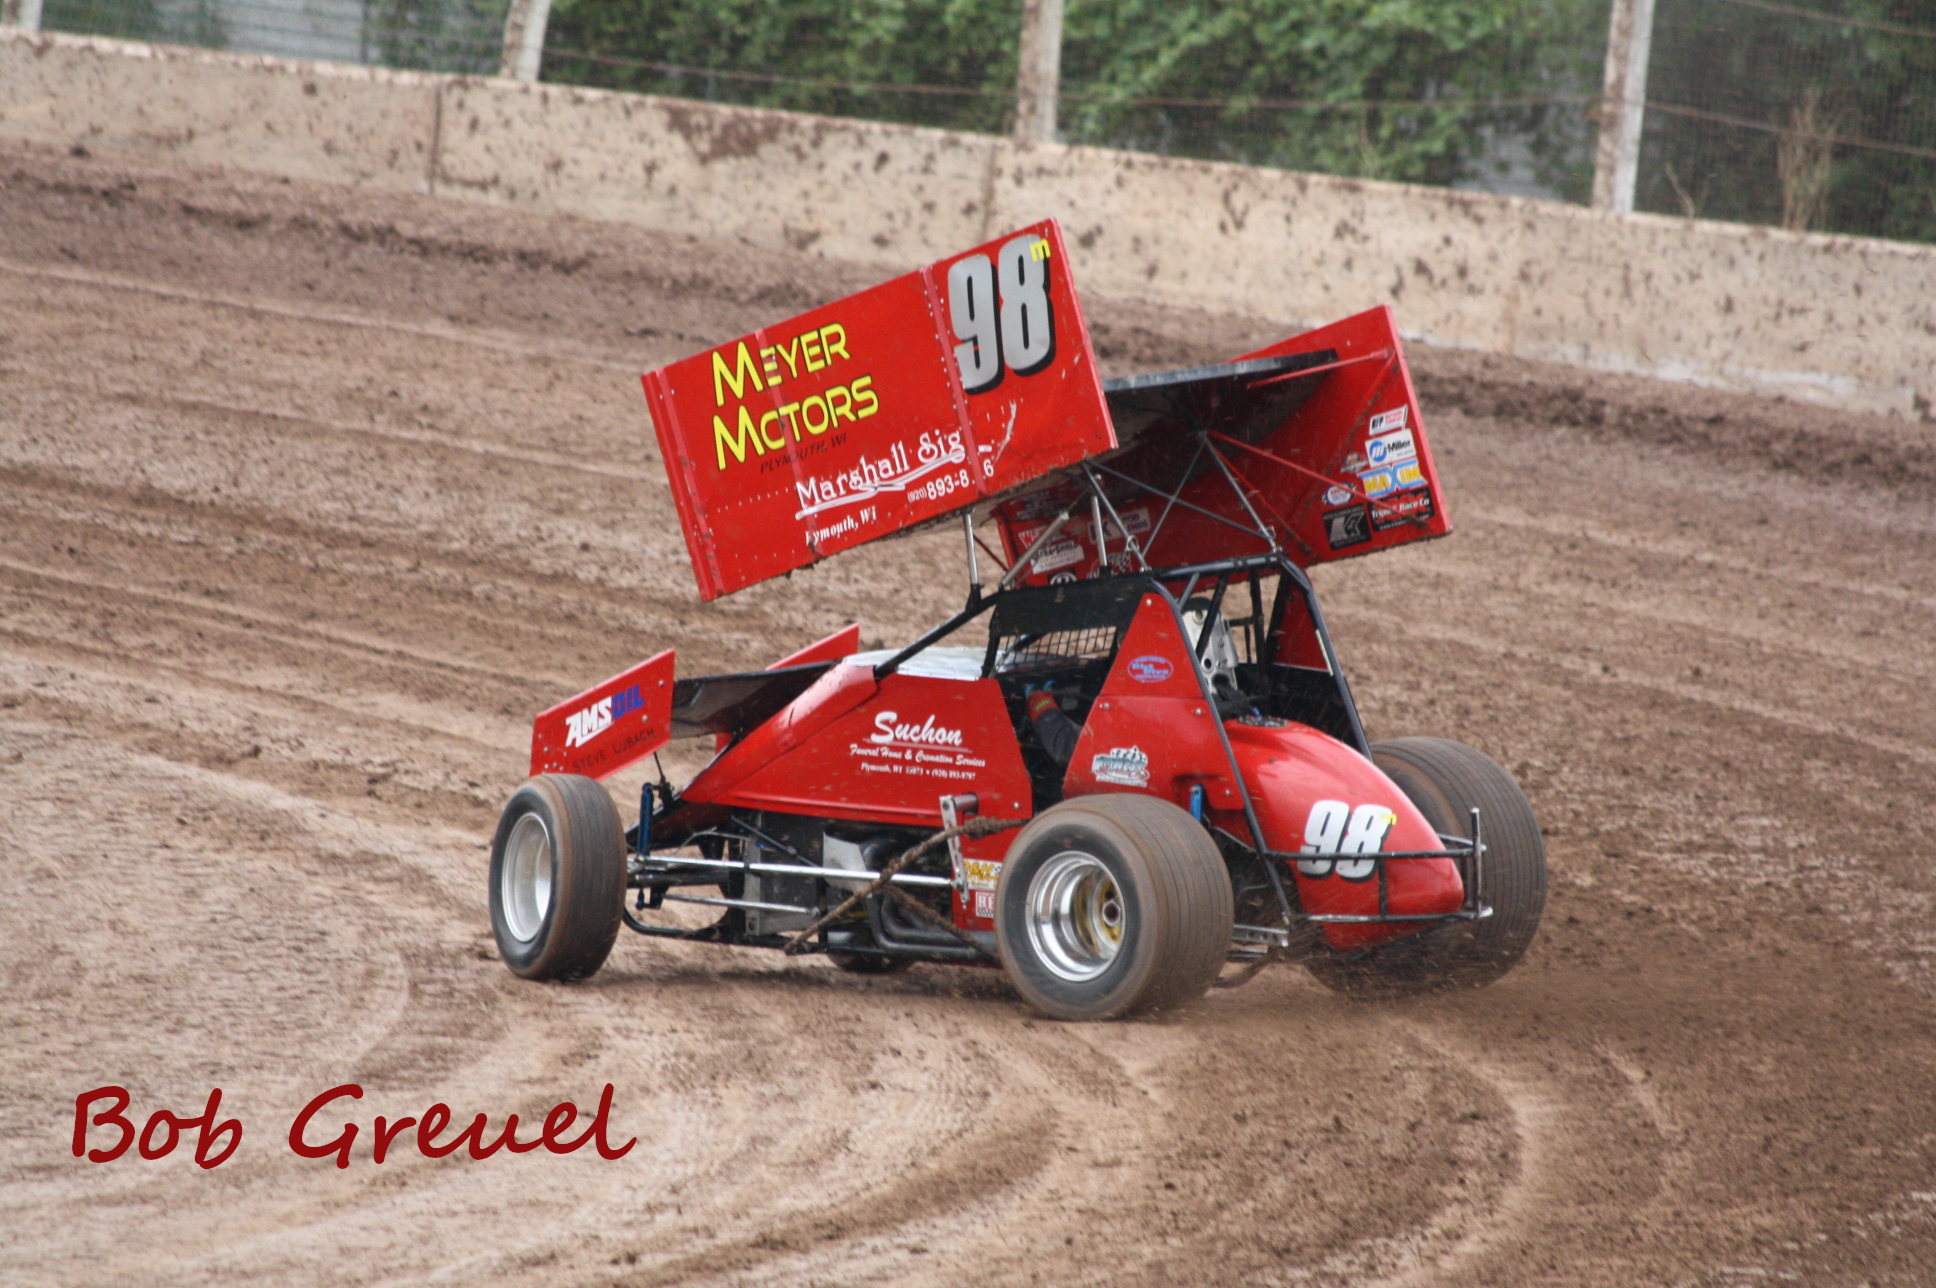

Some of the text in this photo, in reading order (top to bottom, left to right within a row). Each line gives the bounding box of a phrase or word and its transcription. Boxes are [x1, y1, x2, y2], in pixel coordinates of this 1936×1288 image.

[712, 322, 851, 407] MEYER
[712, 374, 879, 471] MOTORS
[831, 432, 847, 448] WI
[1386, 438, 1411, 453] Miller
[795, 441, 909, 509] Marshall
[1361, 460, 1424, 497] MAXIM
[860, 505, 878, 525] WI
[565, 684, 645, 748] AMSOIL
[870, 710, 963, 746] Suchon
[572, 727, 655, 773] STEVE LUBACH
[849, 743, 986, 768] Funeral Home & Cremation Services
